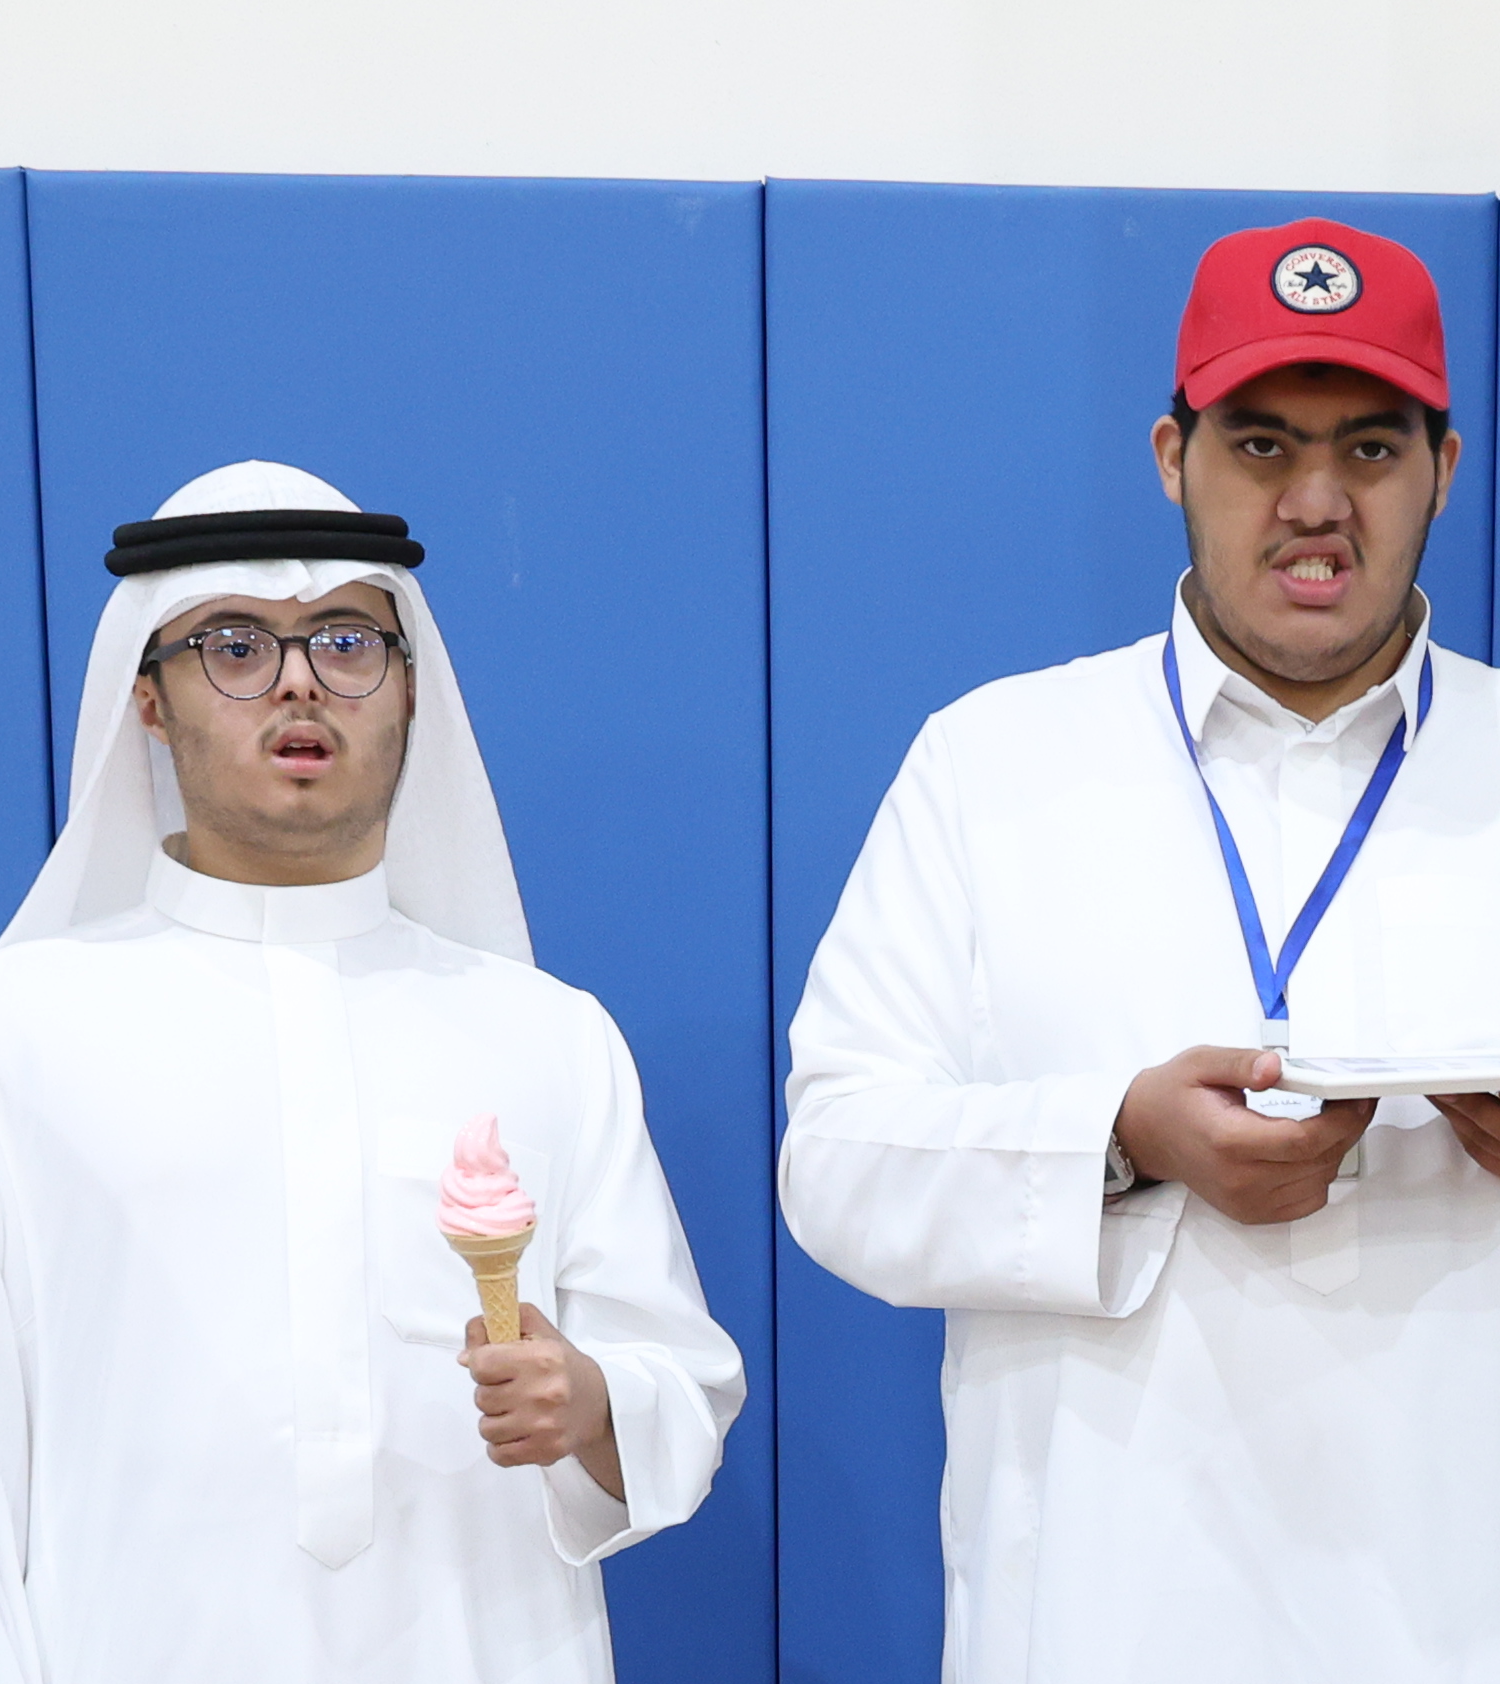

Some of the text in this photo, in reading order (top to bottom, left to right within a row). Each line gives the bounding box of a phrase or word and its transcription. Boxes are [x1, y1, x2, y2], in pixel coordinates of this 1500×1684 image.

[1286, 253, 1346, 273] CONVERSE
[1287, 291, 1343, 305] ALL STAR
